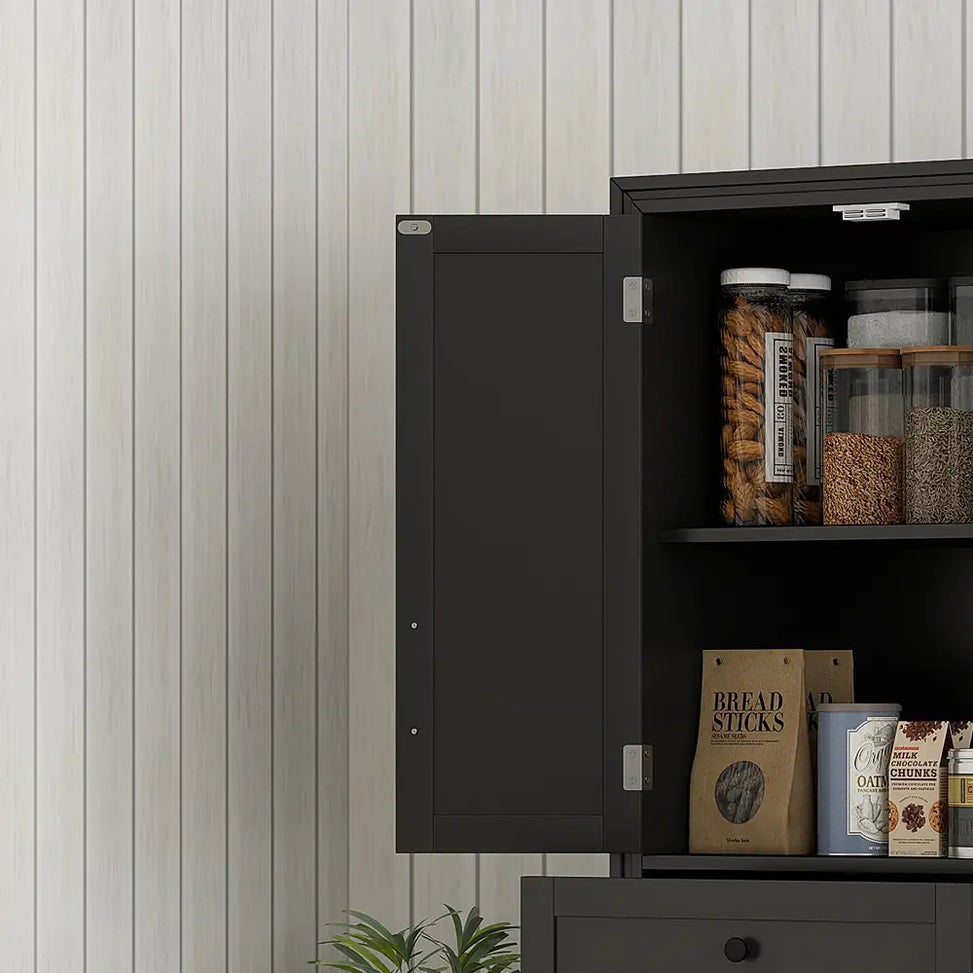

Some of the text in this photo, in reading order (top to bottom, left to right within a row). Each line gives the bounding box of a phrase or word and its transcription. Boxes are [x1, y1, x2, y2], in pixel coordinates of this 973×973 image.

[712, 691, 783, 711] BREAD
[712, 711, 784, 732] STICKS
[890, 768, 937, 777] CHUNKS
